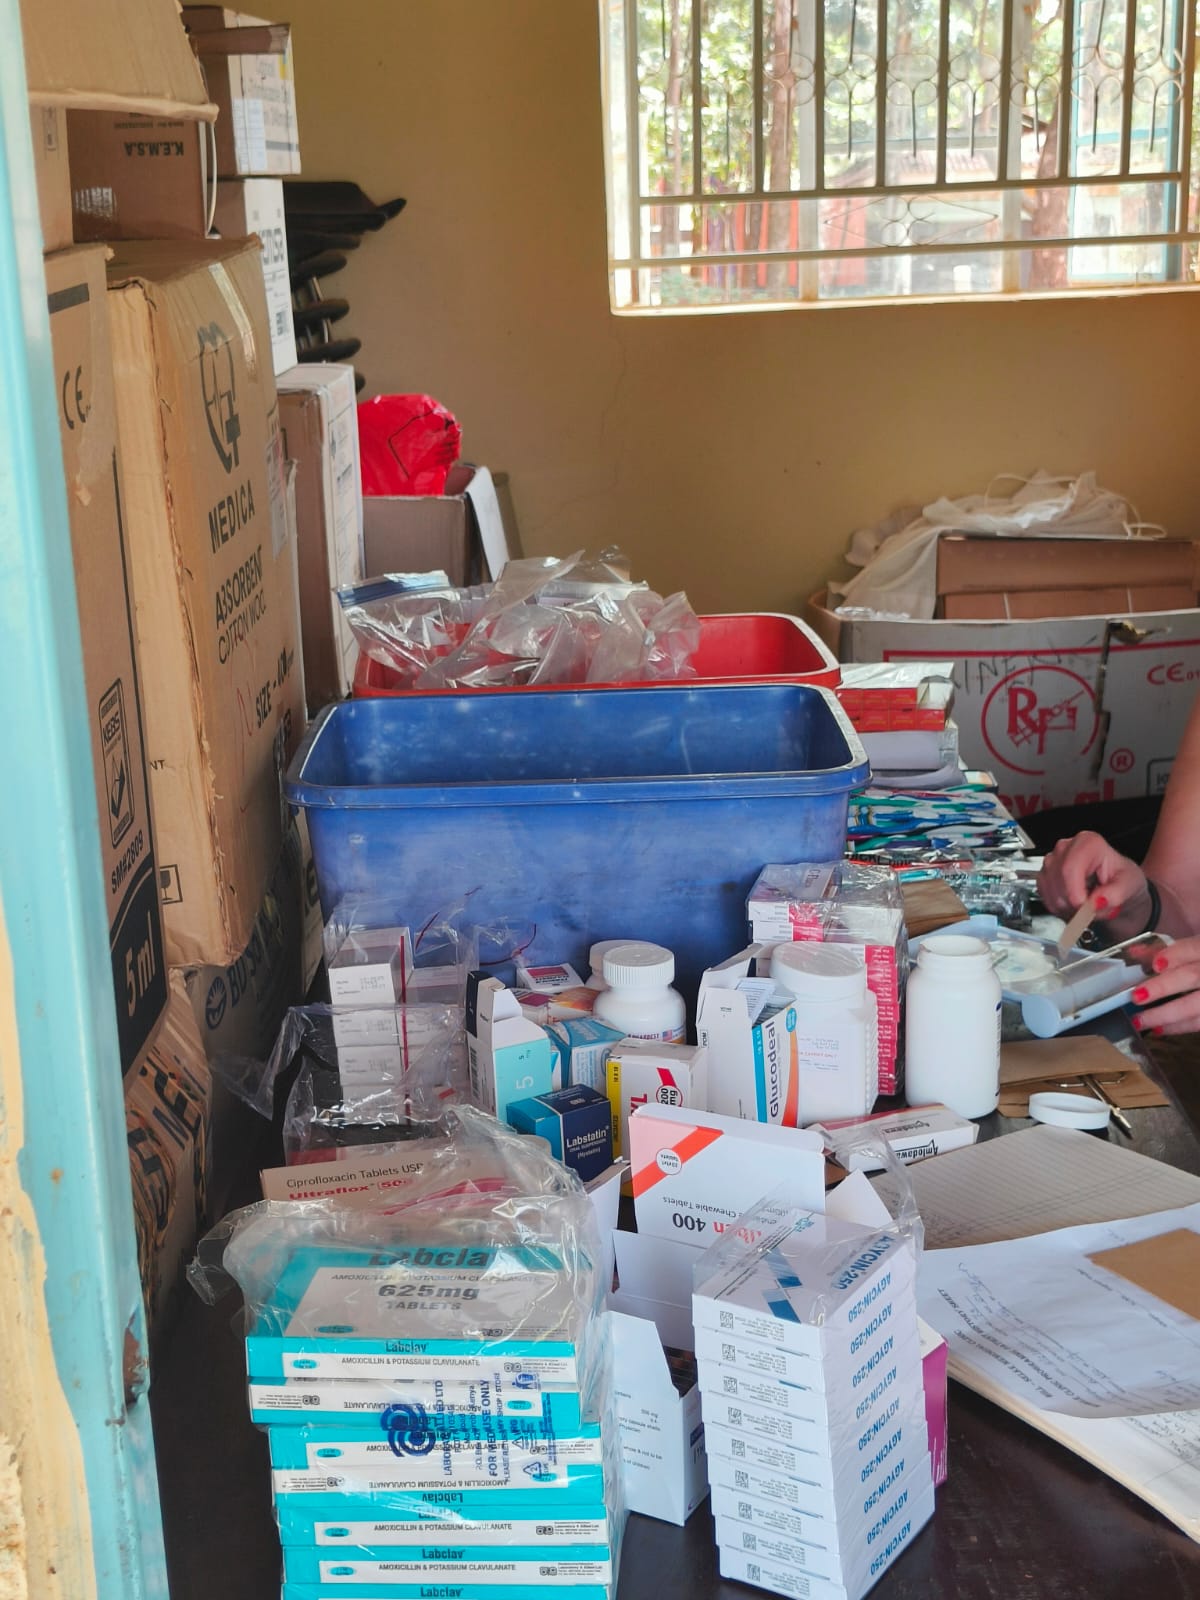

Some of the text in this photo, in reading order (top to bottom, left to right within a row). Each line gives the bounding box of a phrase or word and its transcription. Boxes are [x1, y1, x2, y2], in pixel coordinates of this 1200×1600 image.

[124, 142, 184, 157] K.E.M.S.A
[208, 479, 256, 554] MEDICA
[765, 1021, 779, 1118] Glucodeal
[660, 1088, 669, 1104] 200
[669, 1090, 678, 1105] mg
[566, 1129, 607, 1148] Labstatin
[286, 1173, 357, 1189] Ciprofloxacin
[360, 1166, 399, 1179] Tablets
[662, 1196, 737, 1218] Chewable Tablets
[672, 1212, 706, 1233] 400
[367, 1247, 489, 1267] Labcla
[378, 1284, 480, 1301] 625mg
[386, 1301, 462, 1310] TABLETS
[385, 1341, 427, 1352] Labclav
[341, 1357, 385, 1365] AMOXICILLIN
[392, 1358, 431, 1366] POTASSIUM
[432, 1359, 480, 1367] CLAVULANATE
[435, 1380, 443, 1397] LTD
[480, 1379, 490, 1407] ONLY
[488, 1456, 498, 1477] FOR
[422, 1492, 464, 1503] Labclav
[422, 1548, 464, 1559] Labclav
[420, 1587, 462, 1598] Labclav
